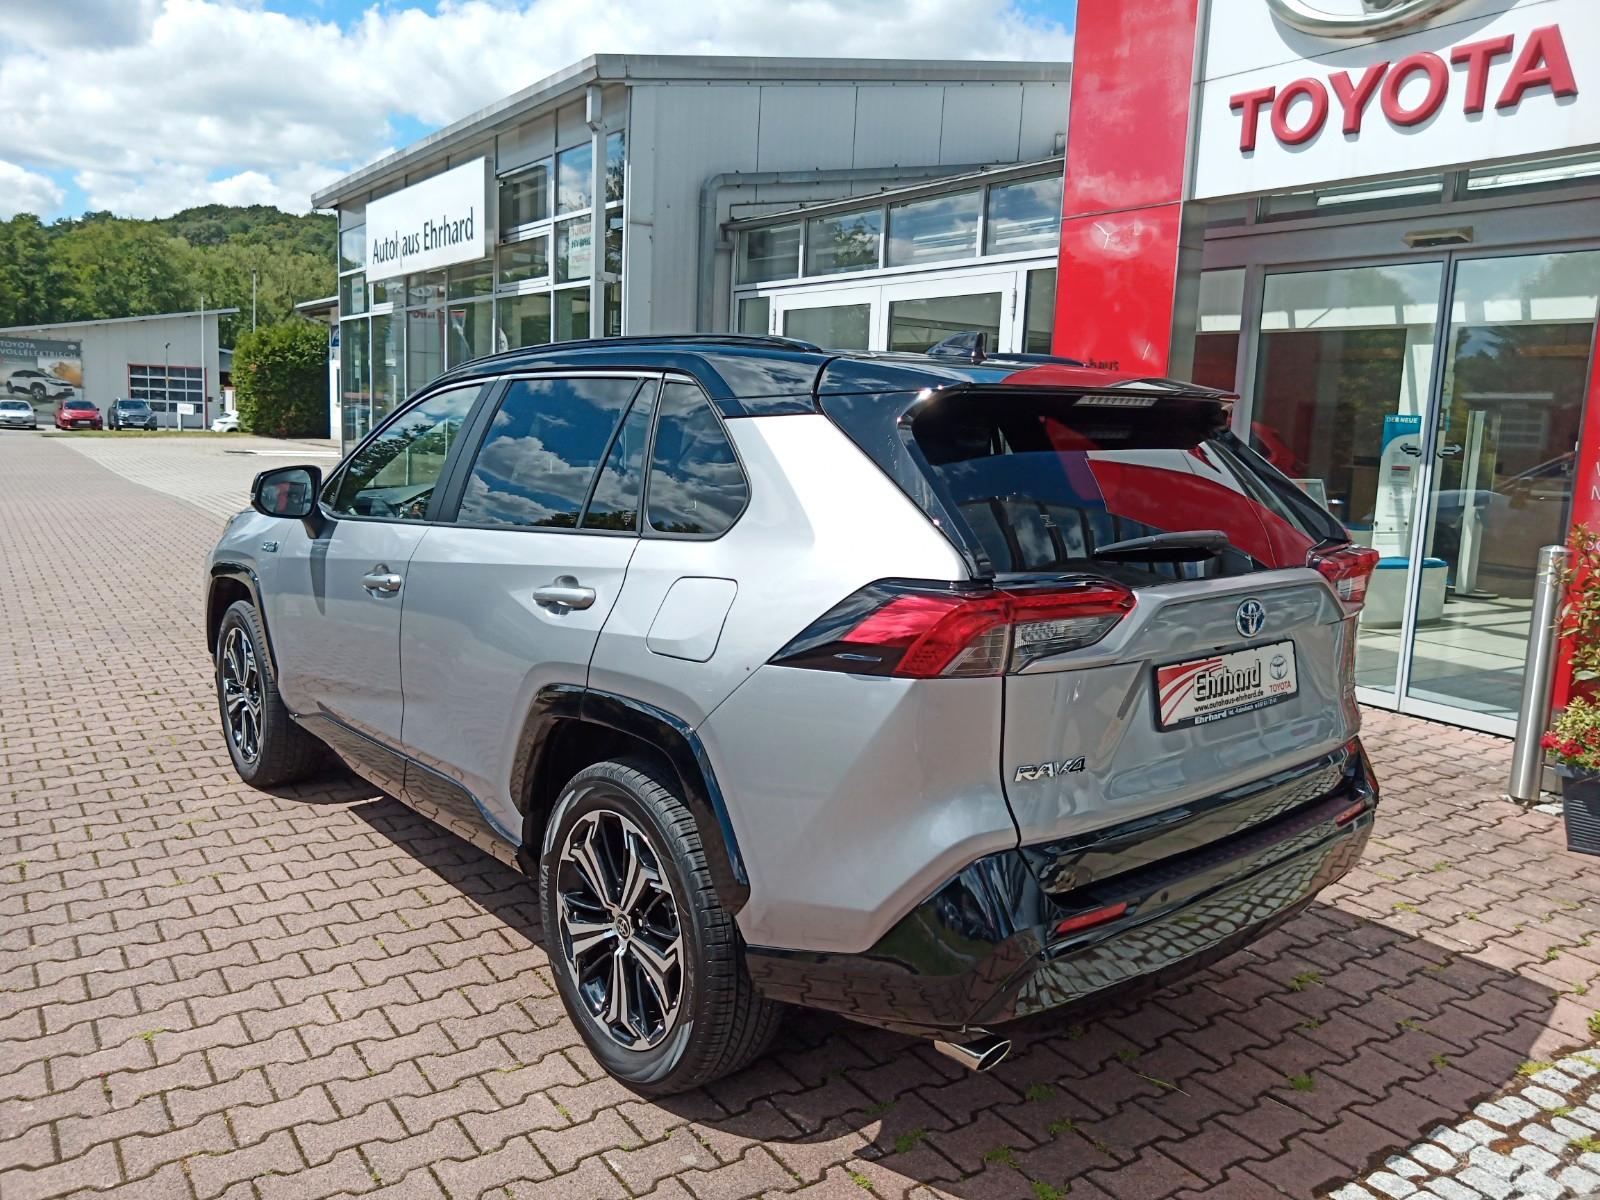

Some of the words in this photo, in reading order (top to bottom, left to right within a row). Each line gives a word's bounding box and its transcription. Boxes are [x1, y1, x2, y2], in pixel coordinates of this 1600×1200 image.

[1229, 23, 1578, 152] TOYOTA
[373, 230, 420, 266] Autohaus
[423, 206, 474, 251] Ehrhard
[0, 340, 36, 350] TOYOTA
[1193, 659, 1261, 702] Ehrhard
[1269, 680, 1292, 693] TOYOTA
[1194, 689, 1264, 713] www.autohaus-ehrhard.de
[1194, 710, 1227, 725] Ehrhard
[1014, 756, 1086, 783] RAV4
